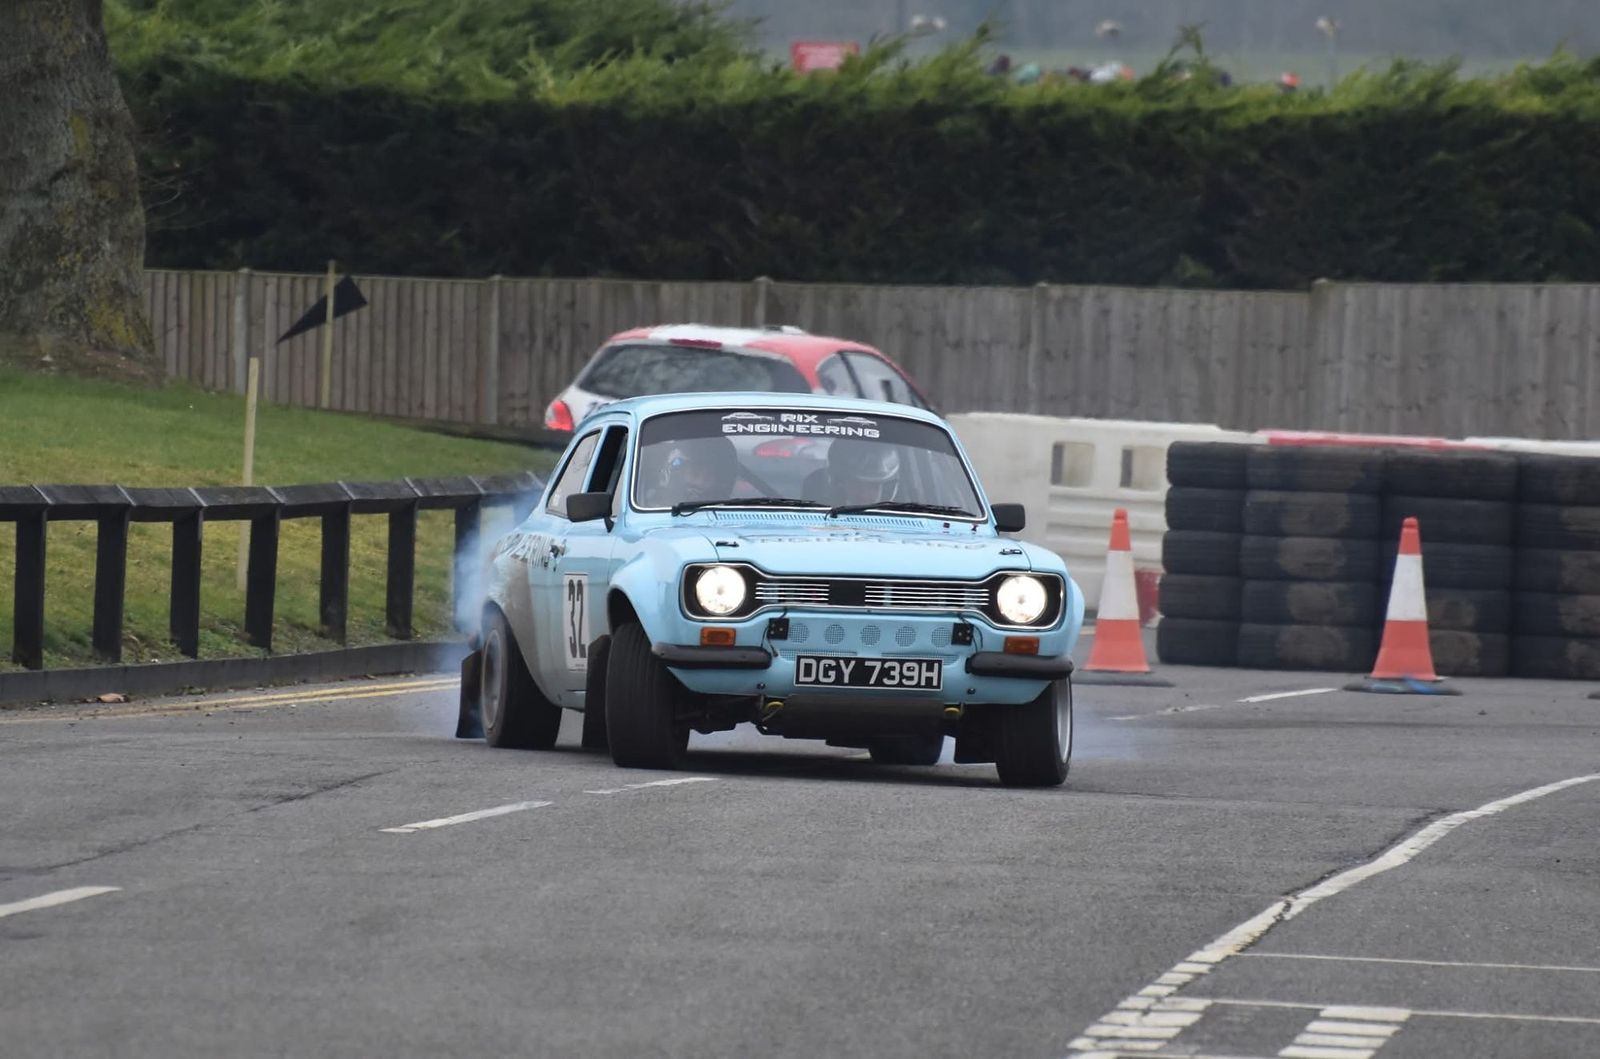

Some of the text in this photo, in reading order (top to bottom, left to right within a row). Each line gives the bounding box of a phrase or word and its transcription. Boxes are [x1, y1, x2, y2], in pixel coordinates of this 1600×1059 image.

[780, 413, 818, 424] RIX
[722, 424, 880, 438] ENGINEERING
[568, 579, 586, 658] 32
[798, 658, 938, 686] DGY 739H
